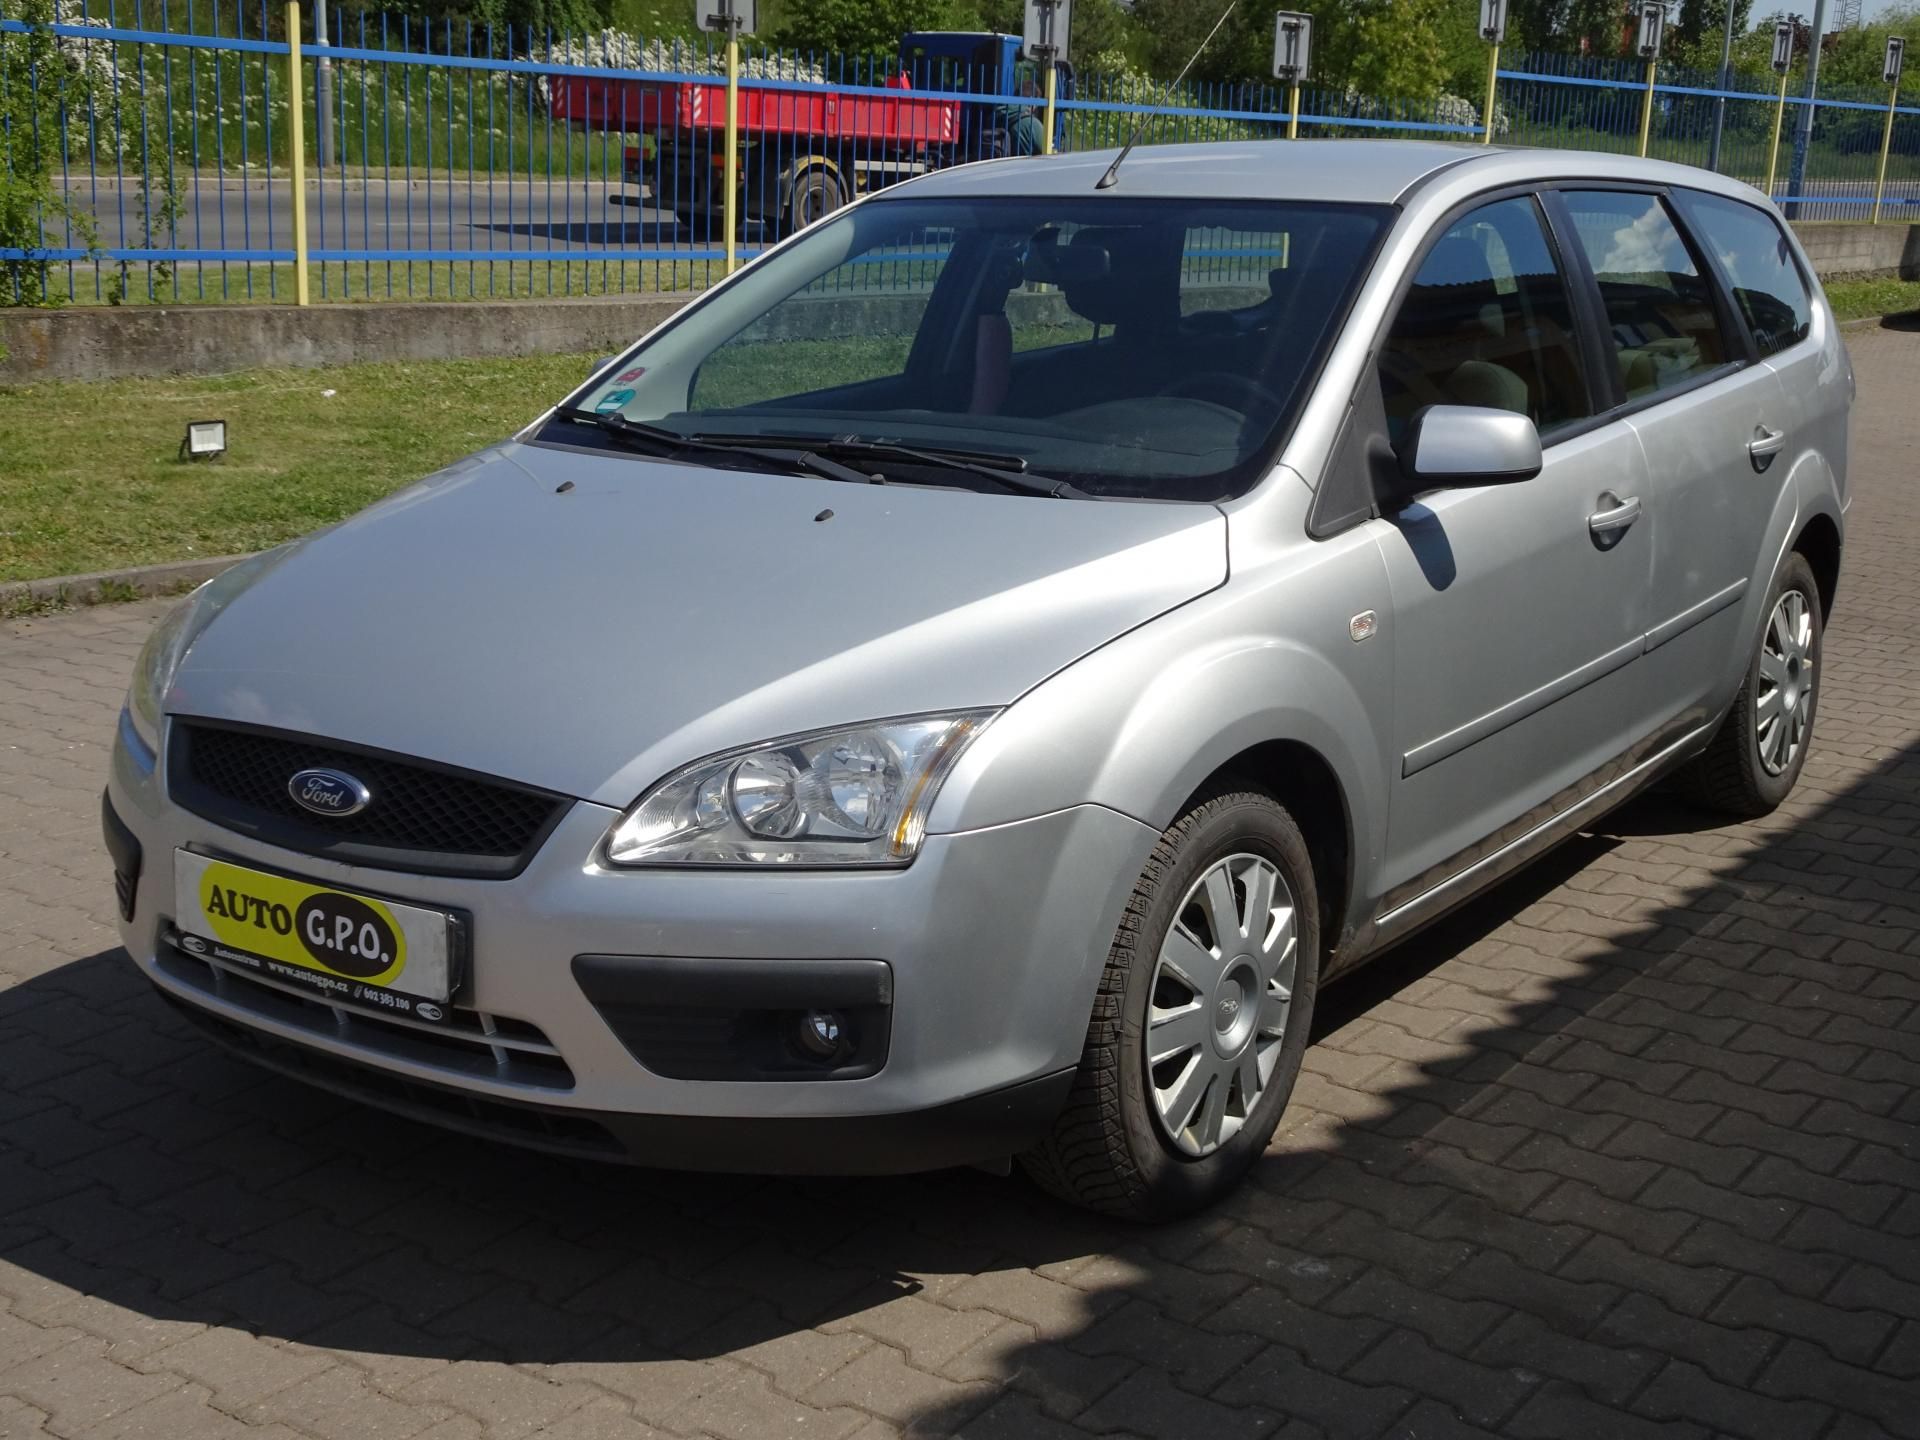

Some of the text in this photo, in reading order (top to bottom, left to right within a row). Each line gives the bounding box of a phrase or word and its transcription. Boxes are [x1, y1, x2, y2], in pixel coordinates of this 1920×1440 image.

[302, 777, 345, 807] Ford
[207, 884, 390, 963] AUTO G.P.O.
[395, 997, 410, 1011] 100
